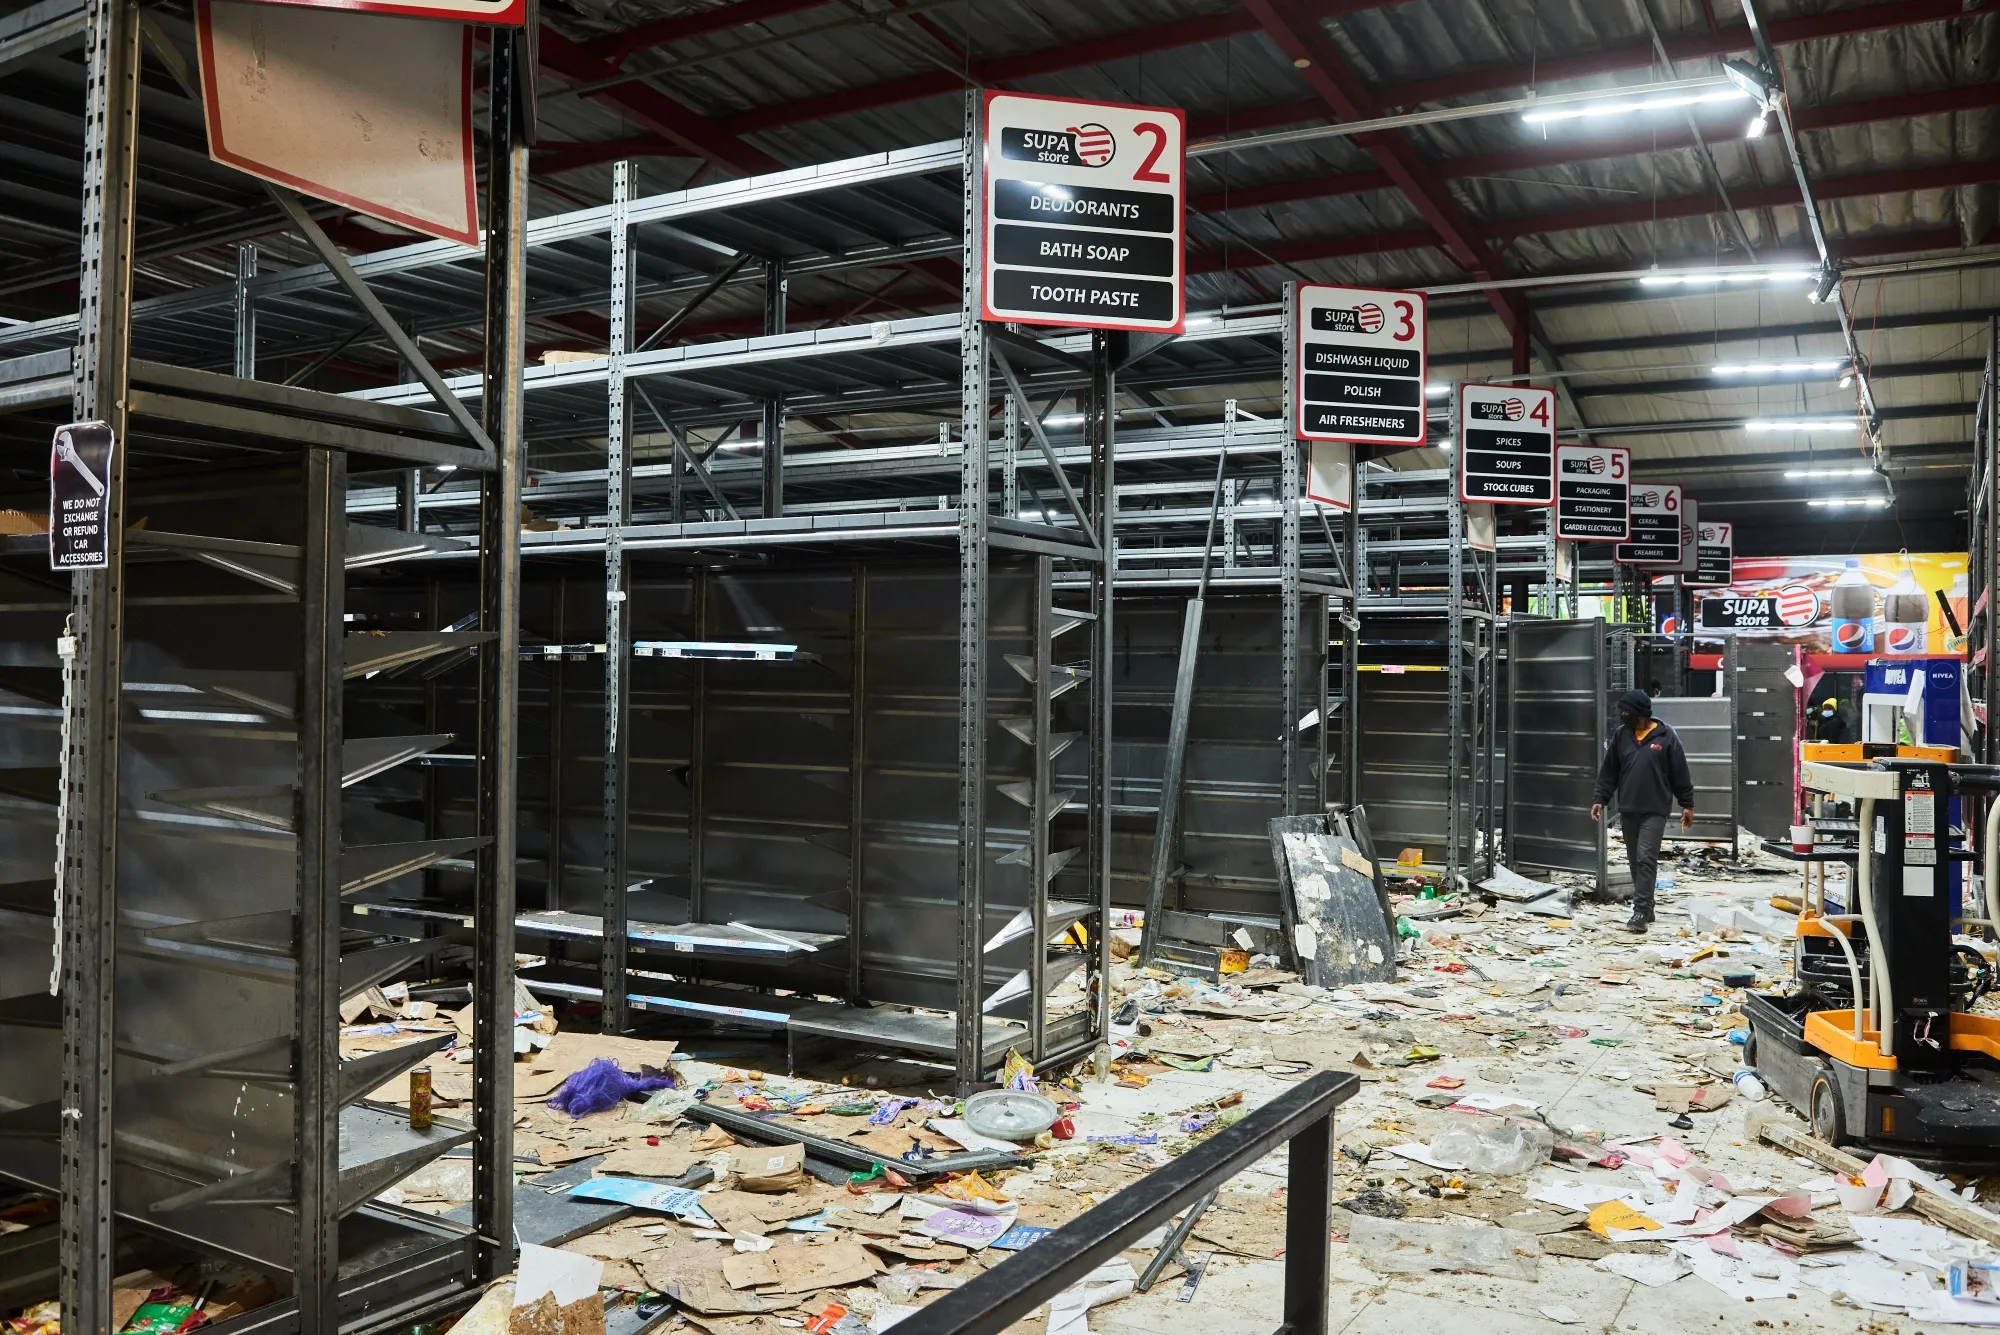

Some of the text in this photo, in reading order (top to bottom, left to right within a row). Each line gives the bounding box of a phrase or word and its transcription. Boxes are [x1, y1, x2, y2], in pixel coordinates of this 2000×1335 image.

[1023, 132, 1070, 151] SUPA
[1037, 150, 1070, 164] store
[1132, 121, 1171, 184] 2
[1029, 195, 1140, 219] DEODORANTS
[1039, 241, 1130, 262] BATH SOAP
[1030, 285, 1140, 307] TOOTH PASTE
[1325, 310, 1355, 324] SUPA
[1392, 300, 1416, 342] 3
[1334, 323, 1355, 332] store
[1315, 352, 1410, 371] DISHWASH LIQUID
[1343, 385, 1382, 397] POLISH
[1481, 404, 1503, 414] SUPA
[1530, 397, 1549, 427] 4
[1318, 414, 1405, 429] AIR FRESHENERS
[1495, 437, 1522, 446] SPICES
[1495, 460, 1522, 469] SOUPS
[1570, 460, 1588, 469] SUPA
[1611, 453, 1625, 479] 5
[1483, 482, 1535, 493] STOCK CUBES
[1576, 486, 1611, 495] PACKAGING
[63, 498, 100, 510] WE DO NOT
[1664, 489, 1678, 512] 6
[1574, 505, 1612, 514] STATIONERY
[64, 511, 98, 524] EXCHANGE
[63, 525, 98, 537] OR REFUND
[1564, 523, 1622, 533] GARDEN ELECTRICALS
[1718, 526, 1729, 544] 7
[74, 539, 88, 549] CAR
[59, 552, 103, 564] ACCESSORIES
[1634, 549, 1664, 557] CREAMERS
[1722, 599, 1769, 615] SUPA
[1734, 614, 1769, 626] store
